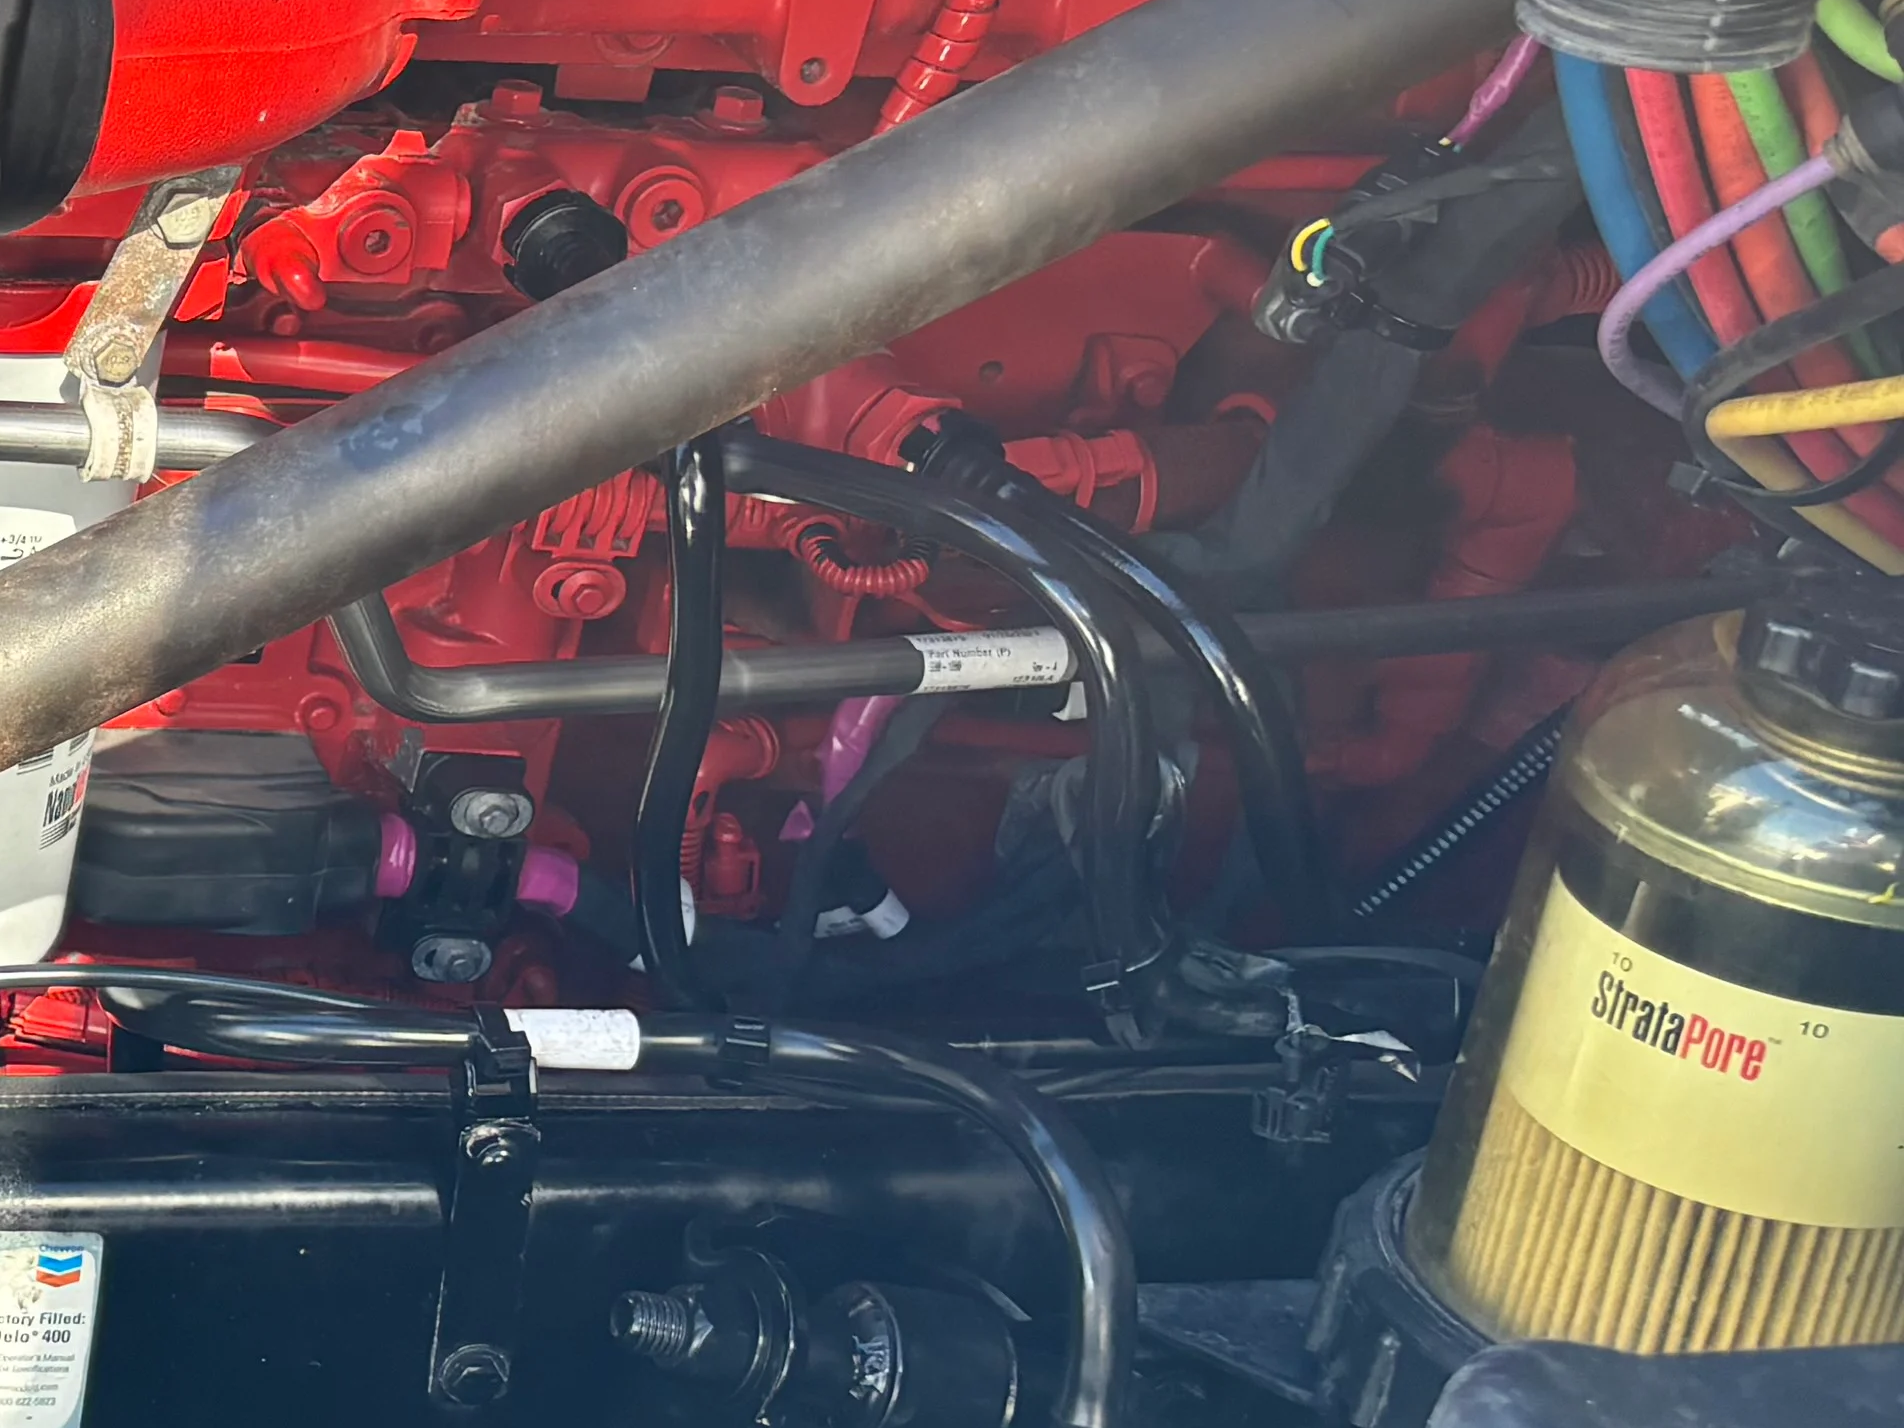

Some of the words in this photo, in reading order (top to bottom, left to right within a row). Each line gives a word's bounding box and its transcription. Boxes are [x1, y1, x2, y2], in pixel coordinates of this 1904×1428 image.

[952, 647, 992, 658] Number
[1612, 952, 1633, 972] 10
[1800, 1021, 1829, 1039] 10
[39, 1313, 86, 1325] Filled:
[42, 1330, 70, 1343] 400
